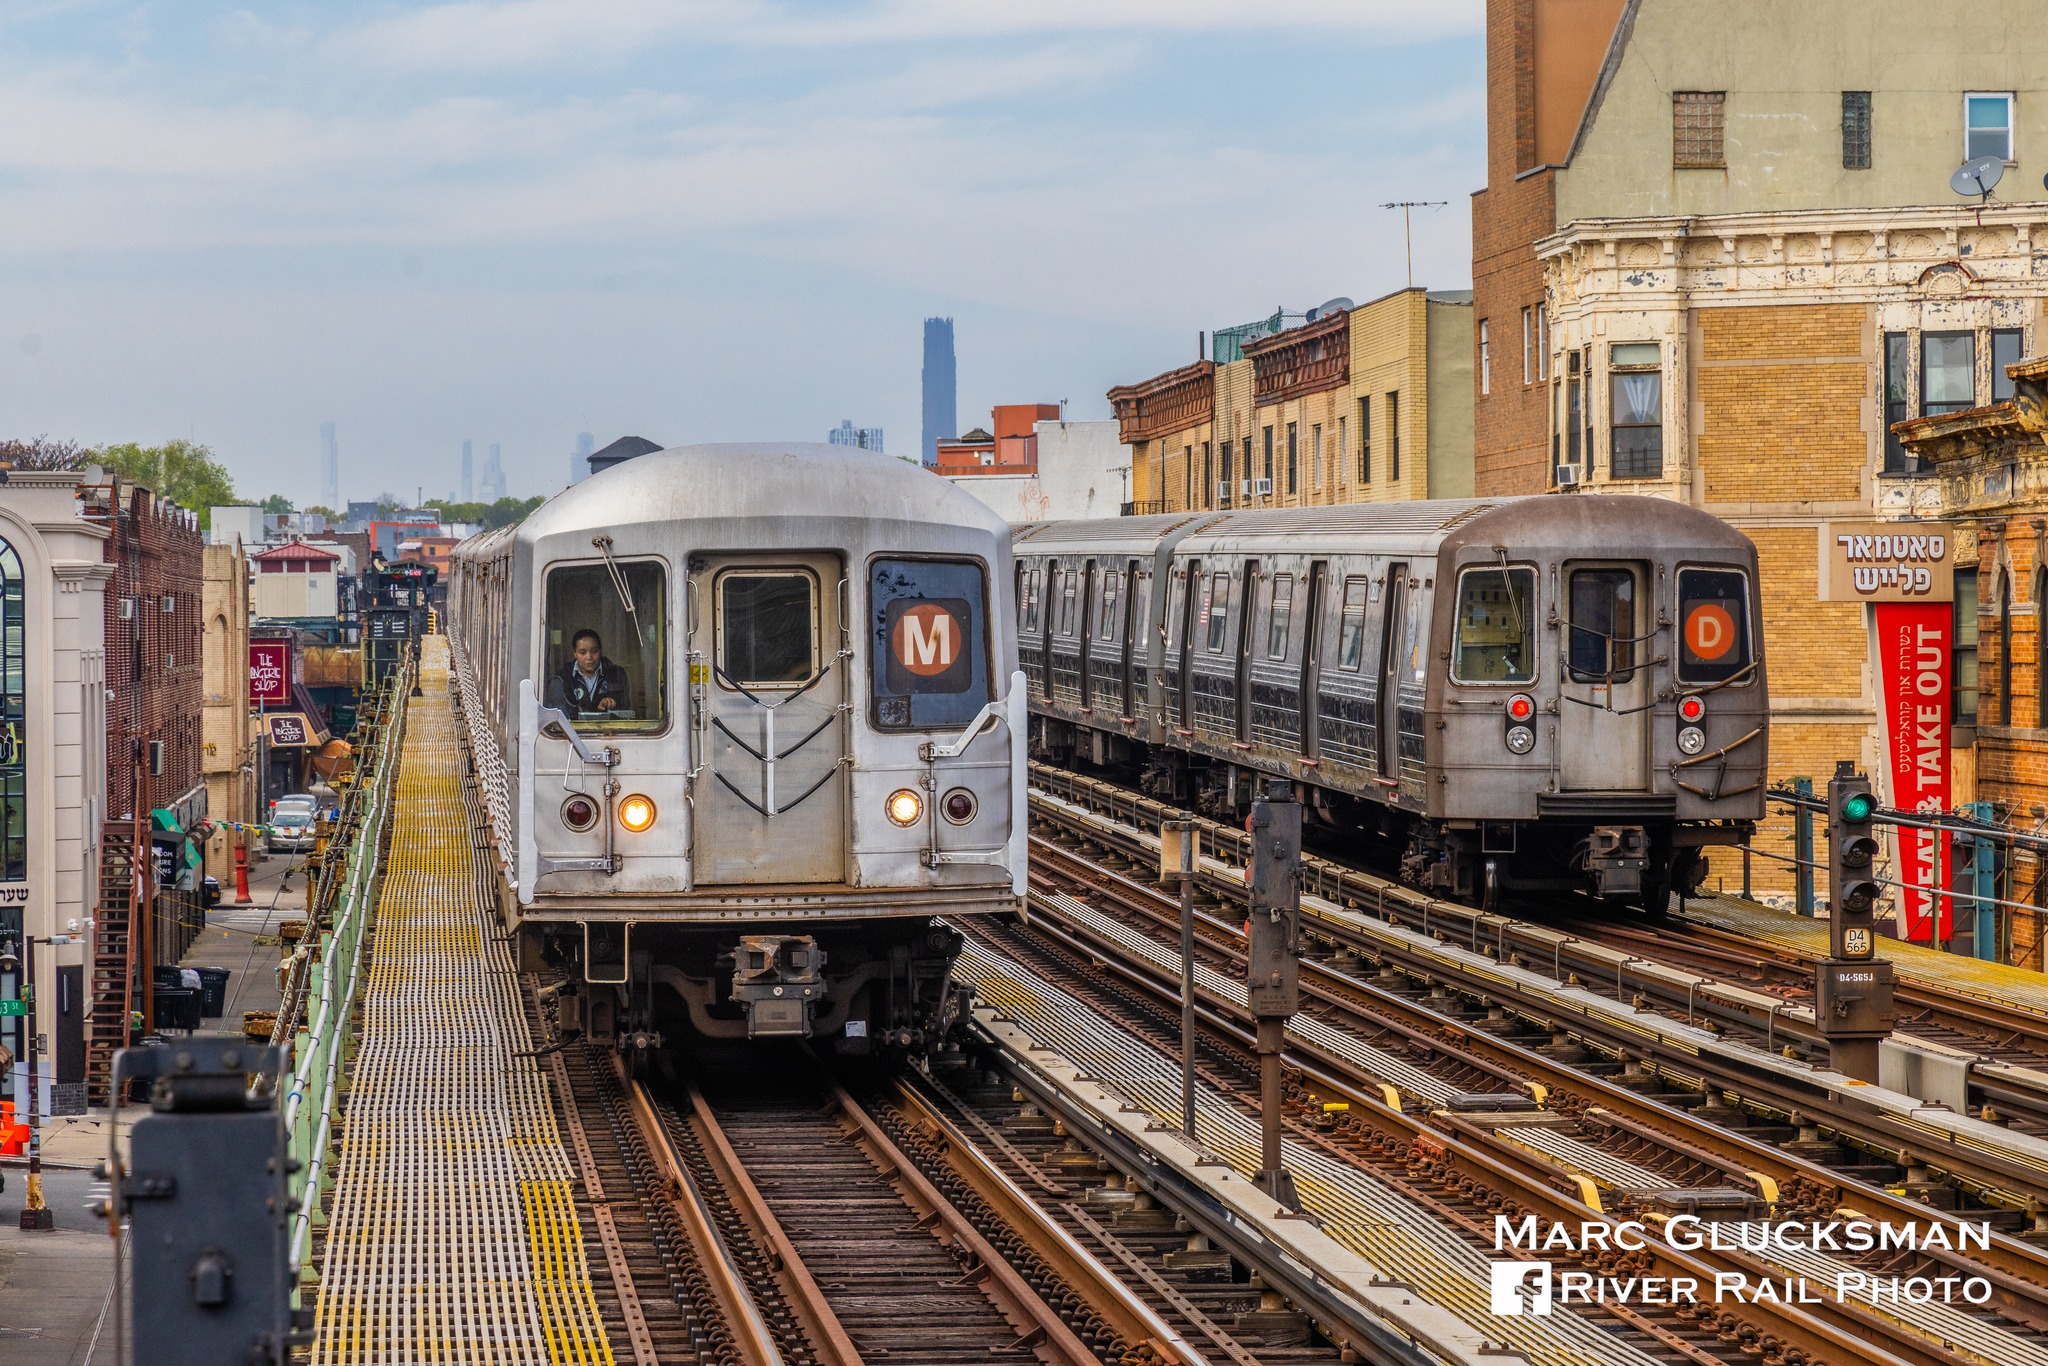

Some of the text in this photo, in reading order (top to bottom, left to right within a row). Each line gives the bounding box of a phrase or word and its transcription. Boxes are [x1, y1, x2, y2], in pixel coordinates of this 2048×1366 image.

[1837, 535, 1946, 562] סאטמאר
[1853, 563, 1932, 595] פלייש
[903, 614, 951, 666] M
[1698, 616, 1722, 648] D
[257, 653, 273, 667] THE
[1899, 625, 1911, 670] כשרות
[1916, 624, 1942, 696] OUT
[253, 679, 278, 692] SHOP
[1899, 676, 1913, 697] און
[280, 734, 300, 742] SHOP
[1916, 704, 1942, 792] TAKE
[1917, 827, 1943, 917] MEAT
[1846, 942, 1867, 952] 565
[1849, 930, 1864, 941] D4
[0, 1002, 19, 1014] 3 St
